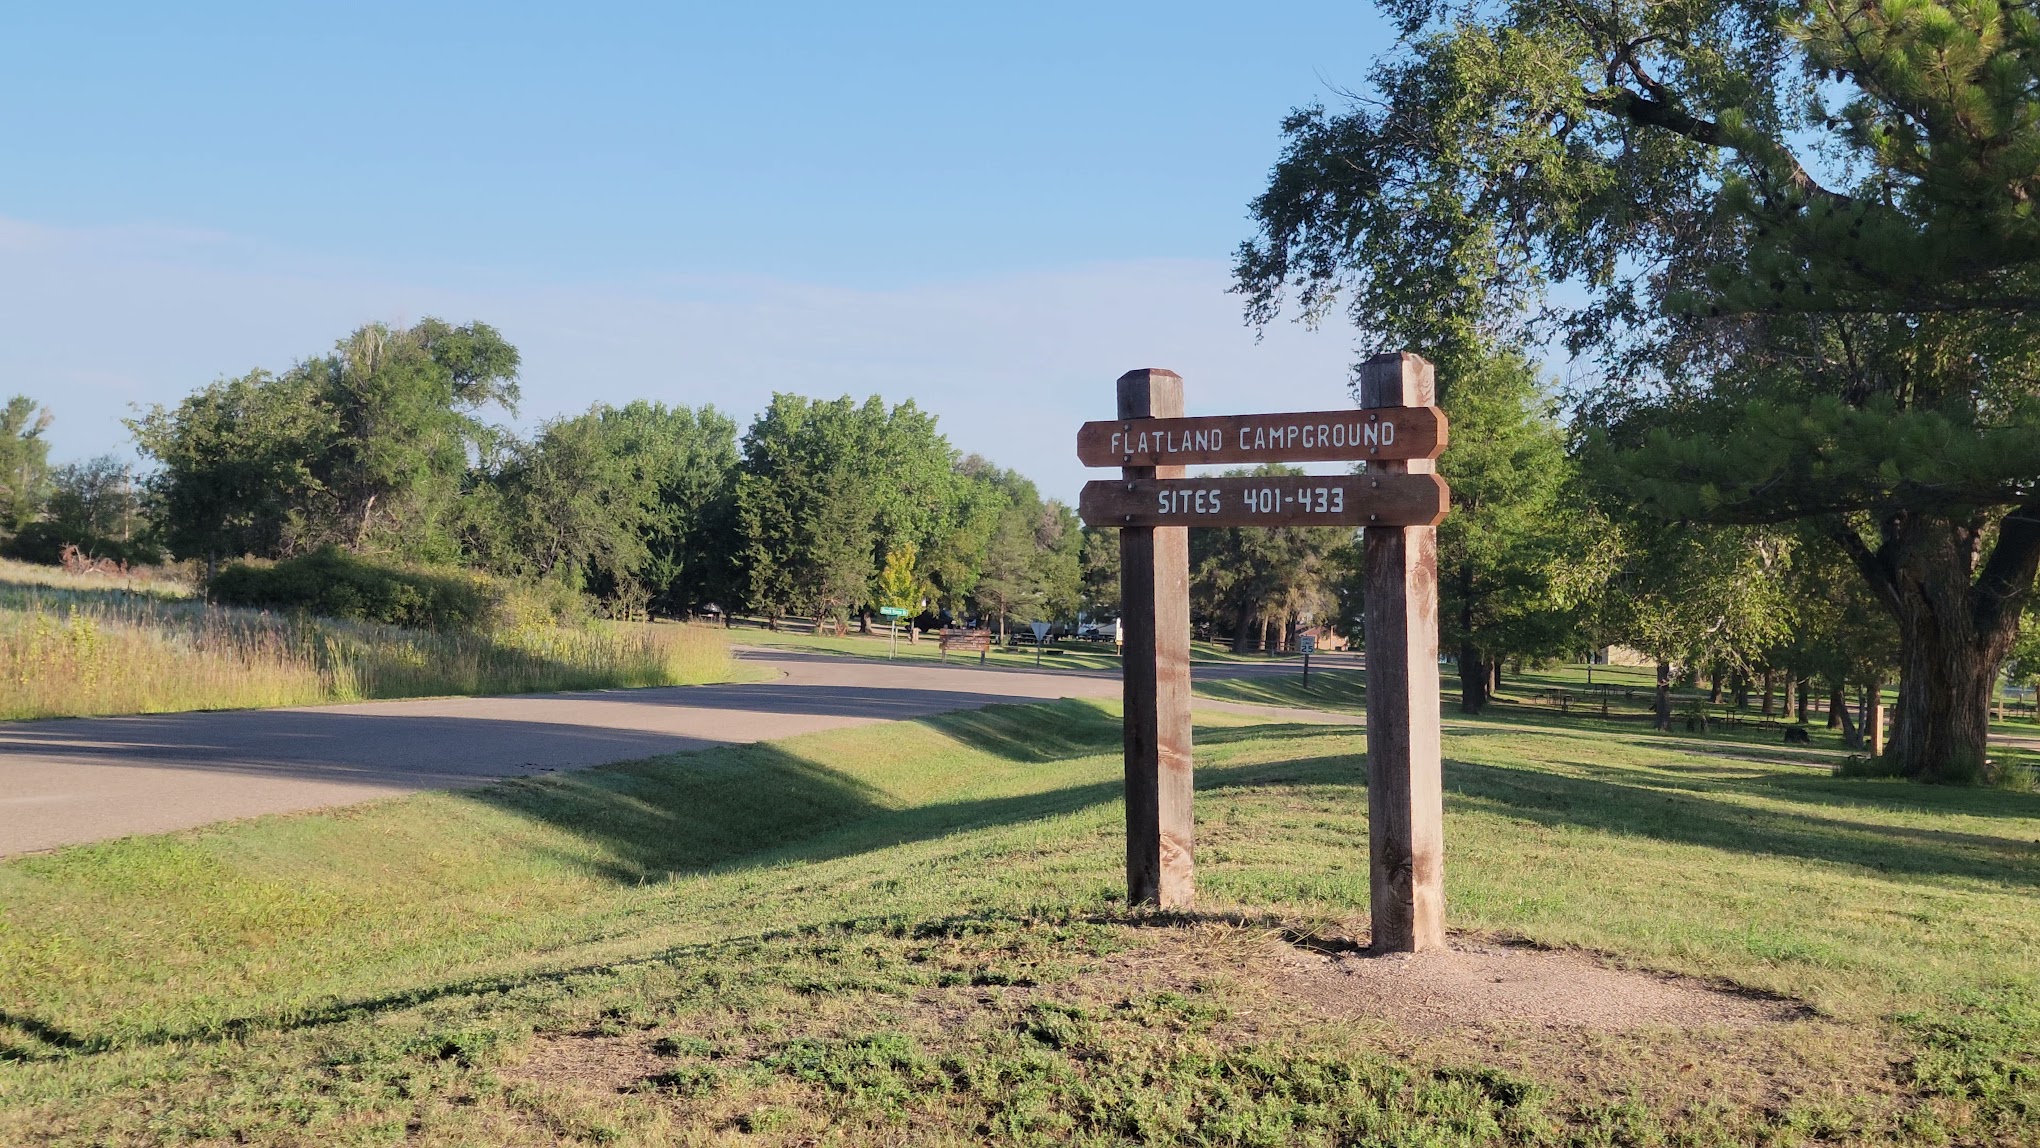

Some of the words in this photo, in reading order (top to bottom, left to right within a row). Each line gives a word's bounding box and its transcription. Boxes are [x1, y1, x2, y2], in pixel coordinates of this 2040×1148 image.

[1111, 429, 1222, 454] FLATLAND
[1239, 422, 1394, 450] CAMPGROUND
[1158, 489, 1221, 514] SITES
[1243, 487, 1344, 513] 401-433
[1301, 645, 1314, 653] 25
